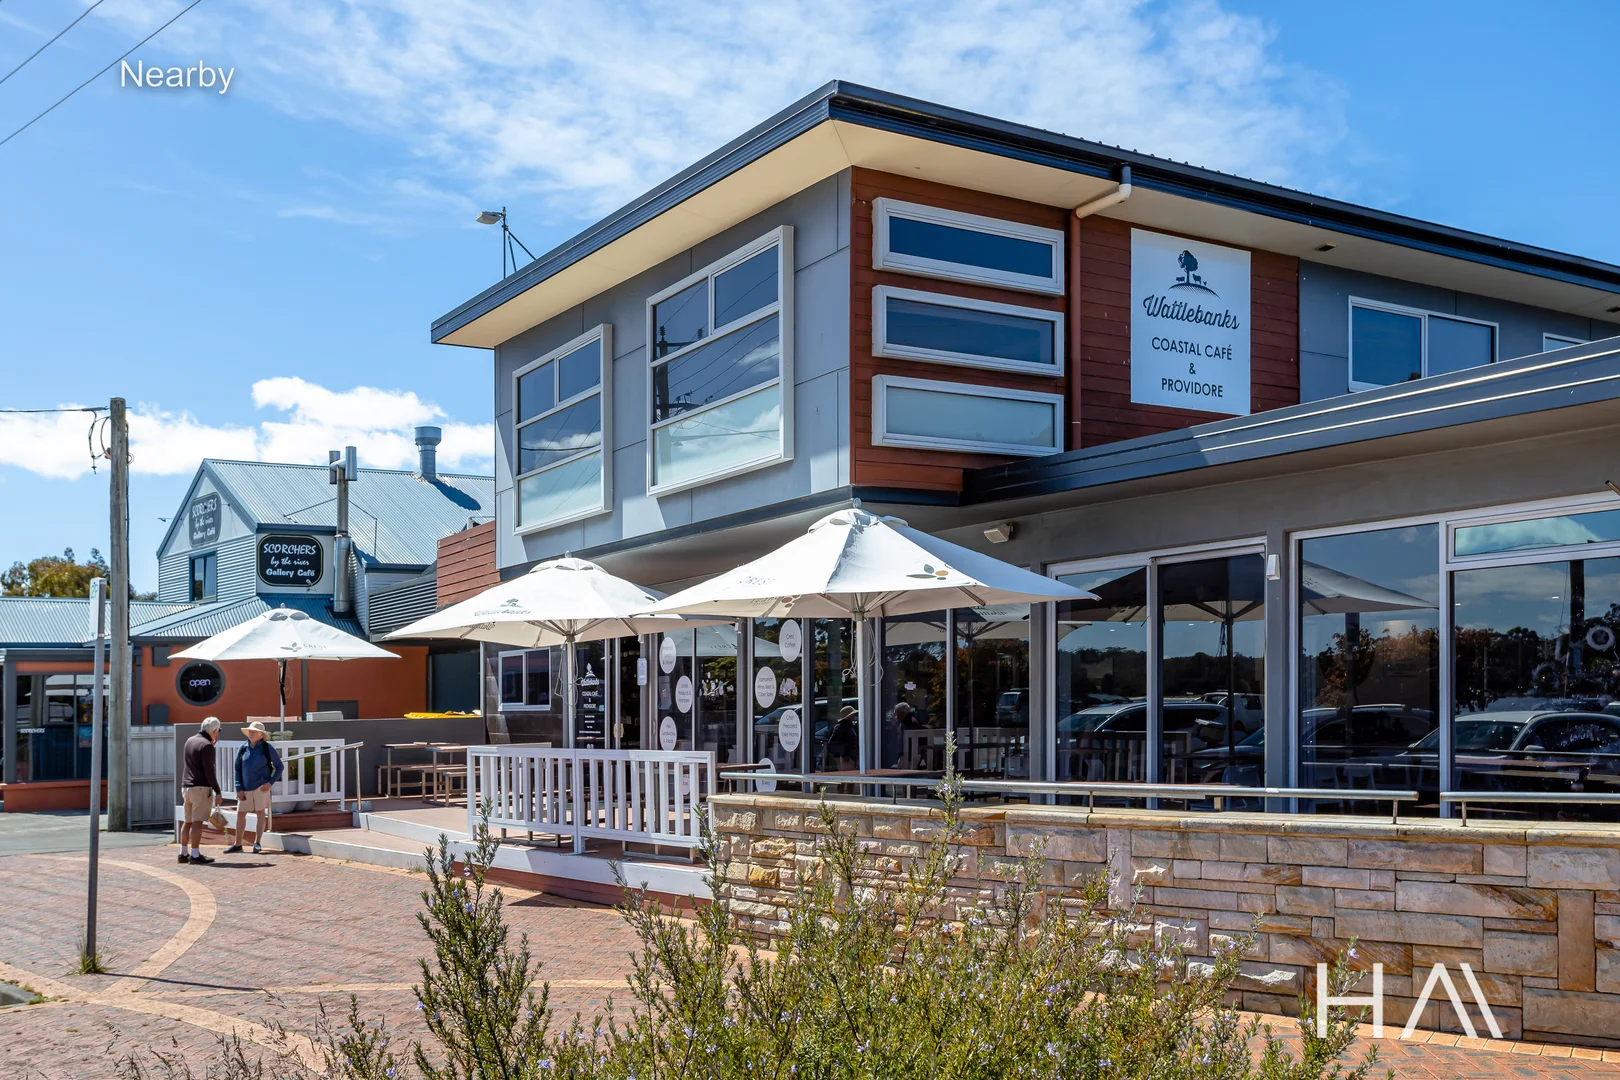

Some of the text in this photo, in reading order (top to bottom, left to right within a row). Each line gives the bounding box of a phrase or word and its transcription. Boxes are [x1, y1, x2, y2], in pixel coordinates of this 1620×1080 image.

[1142, 294, 1240, 330] Wattlebanks
[1152, 336, 1232, 360] COASTAL CAFÉ
[1188, 362, 1196, 375] &
[1162, 378, 1223, 398] PROVIDORE
[193, 527, 216, 540] Gallery Café
[263, 543, 316, 556] SCORCHERS
[270, 556, 279, 567] by
[281, 556, 292, 566] the
[266, 568, 315, 578] Gallery Café
[189, 678, 211, 688] open
